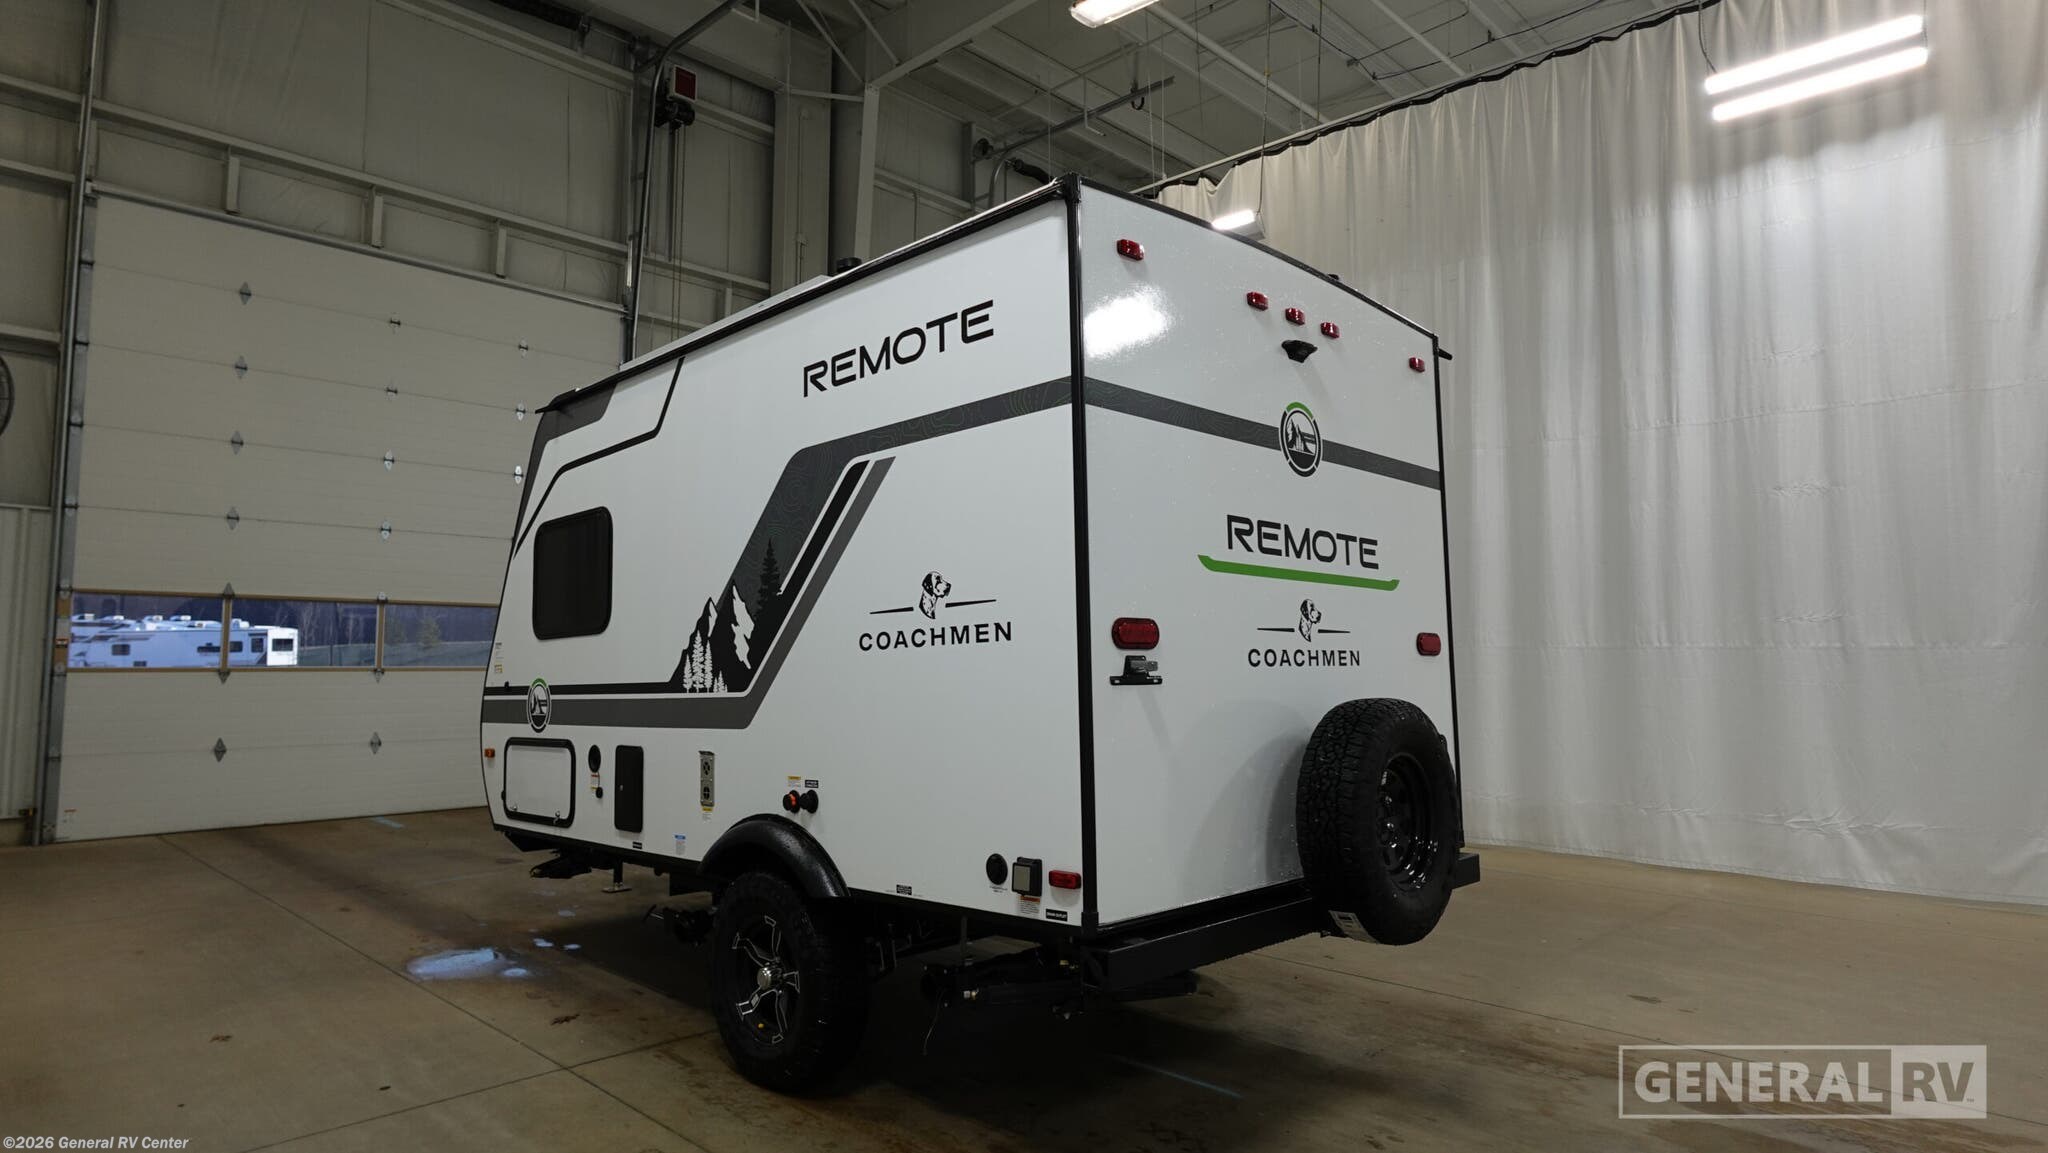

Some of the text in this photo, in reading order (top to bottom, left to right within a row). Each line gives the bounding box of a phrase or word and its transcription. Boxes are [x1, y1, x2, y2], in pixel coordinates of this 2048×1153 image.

[803, 299, 994, 398] REMOTE
[1226, 514, 1380, 570] REMOTE
[858, 621, 1012, 652] COACHMEN
[1247, 648, 1361, 668] COACHMEN
